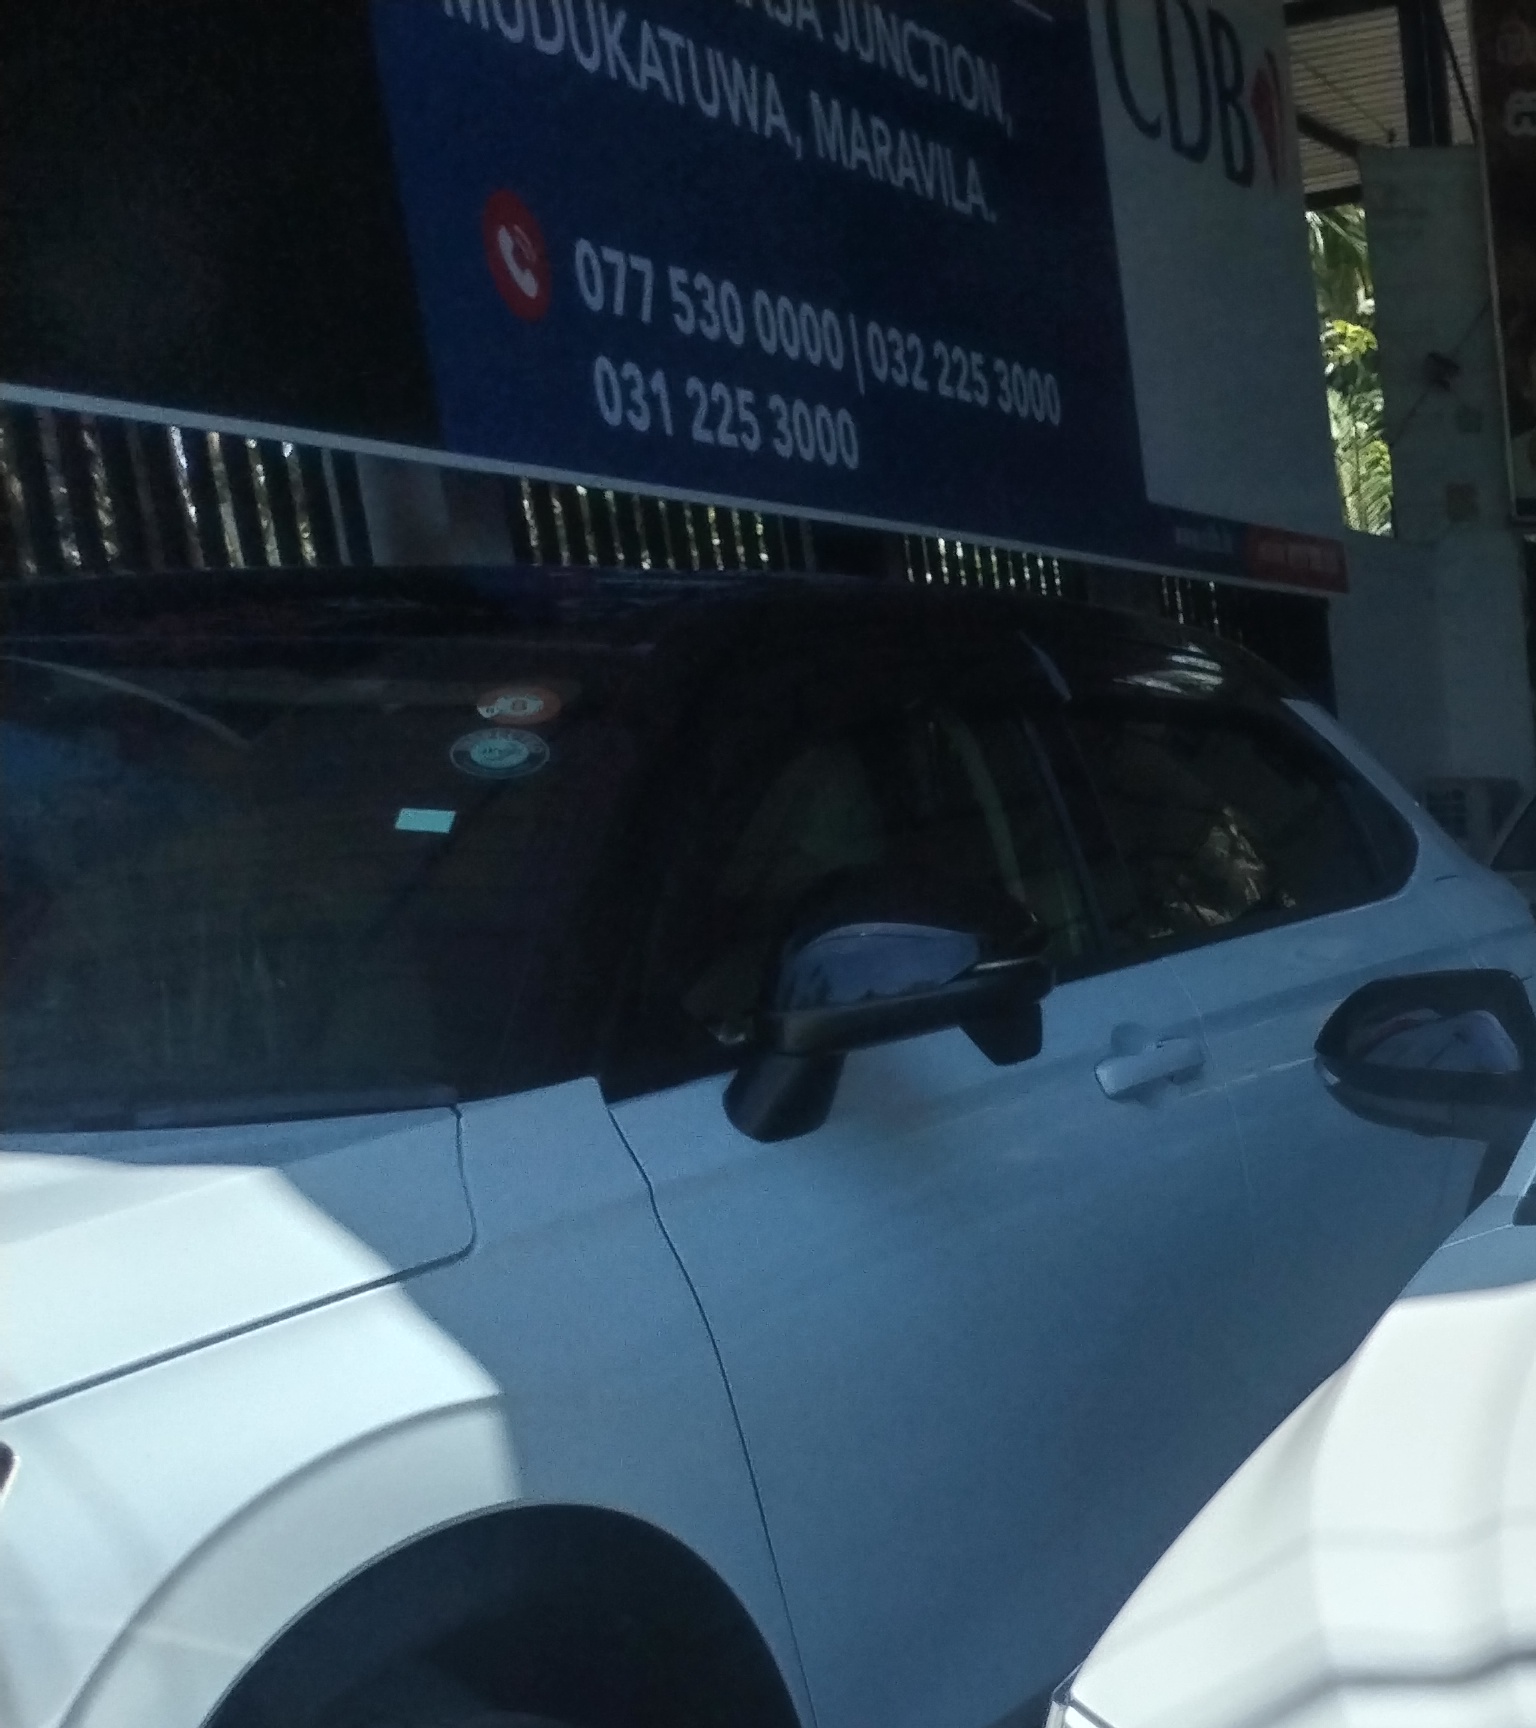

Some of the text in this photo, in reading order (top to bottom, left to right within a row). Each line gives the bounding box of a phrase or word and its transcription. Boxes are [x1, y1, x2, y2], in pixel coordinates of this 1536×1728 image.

[810, 90, 998, 223] MARAVILA.
[575, 238, 654, 324] 077
[669, 264, 745, 346] 530
[754, 290, 843, 371] 0000
[867, 321, 929, 391] 032
[934, 340, 990, 407] 225
[994, 358, 1061, 426] 3000
[594, 355, 859, 470] 031 225 3000
